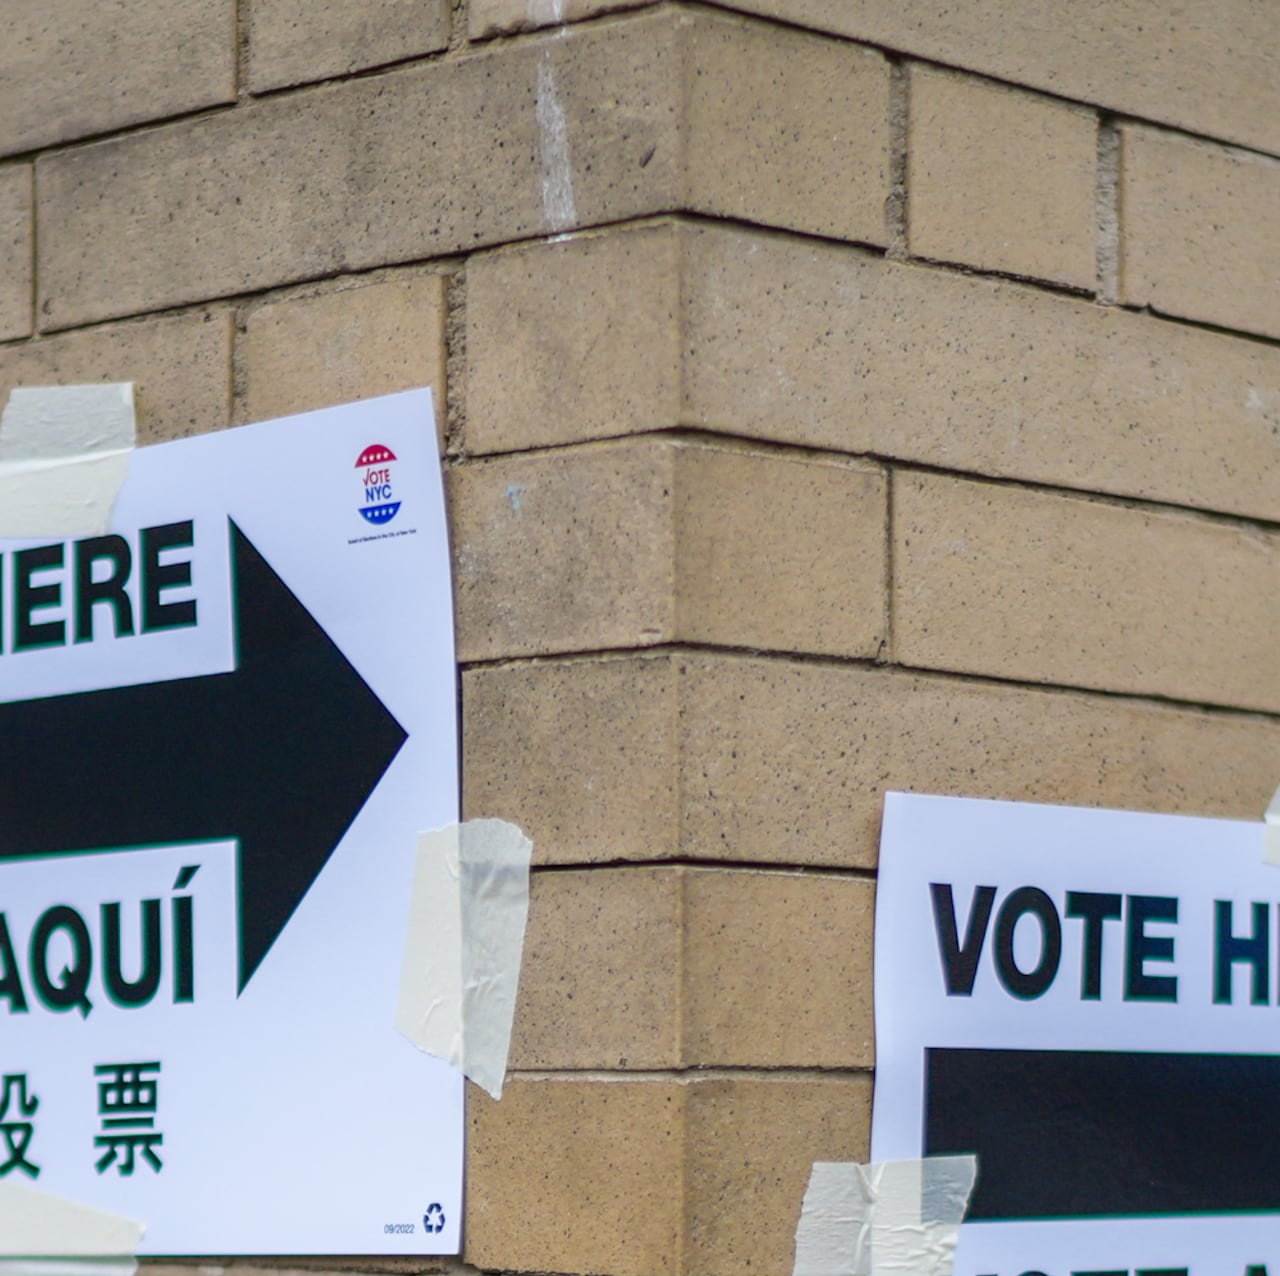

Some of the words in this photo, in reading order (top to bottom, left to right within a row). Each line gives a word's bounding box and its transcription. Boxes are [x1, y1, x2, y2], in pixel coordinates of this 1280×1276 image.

[365, 484, 392, 502] NYC
[928, 881, 1181, 1005] VOTE
[383, 1223, 416, 1235] 09/2022
